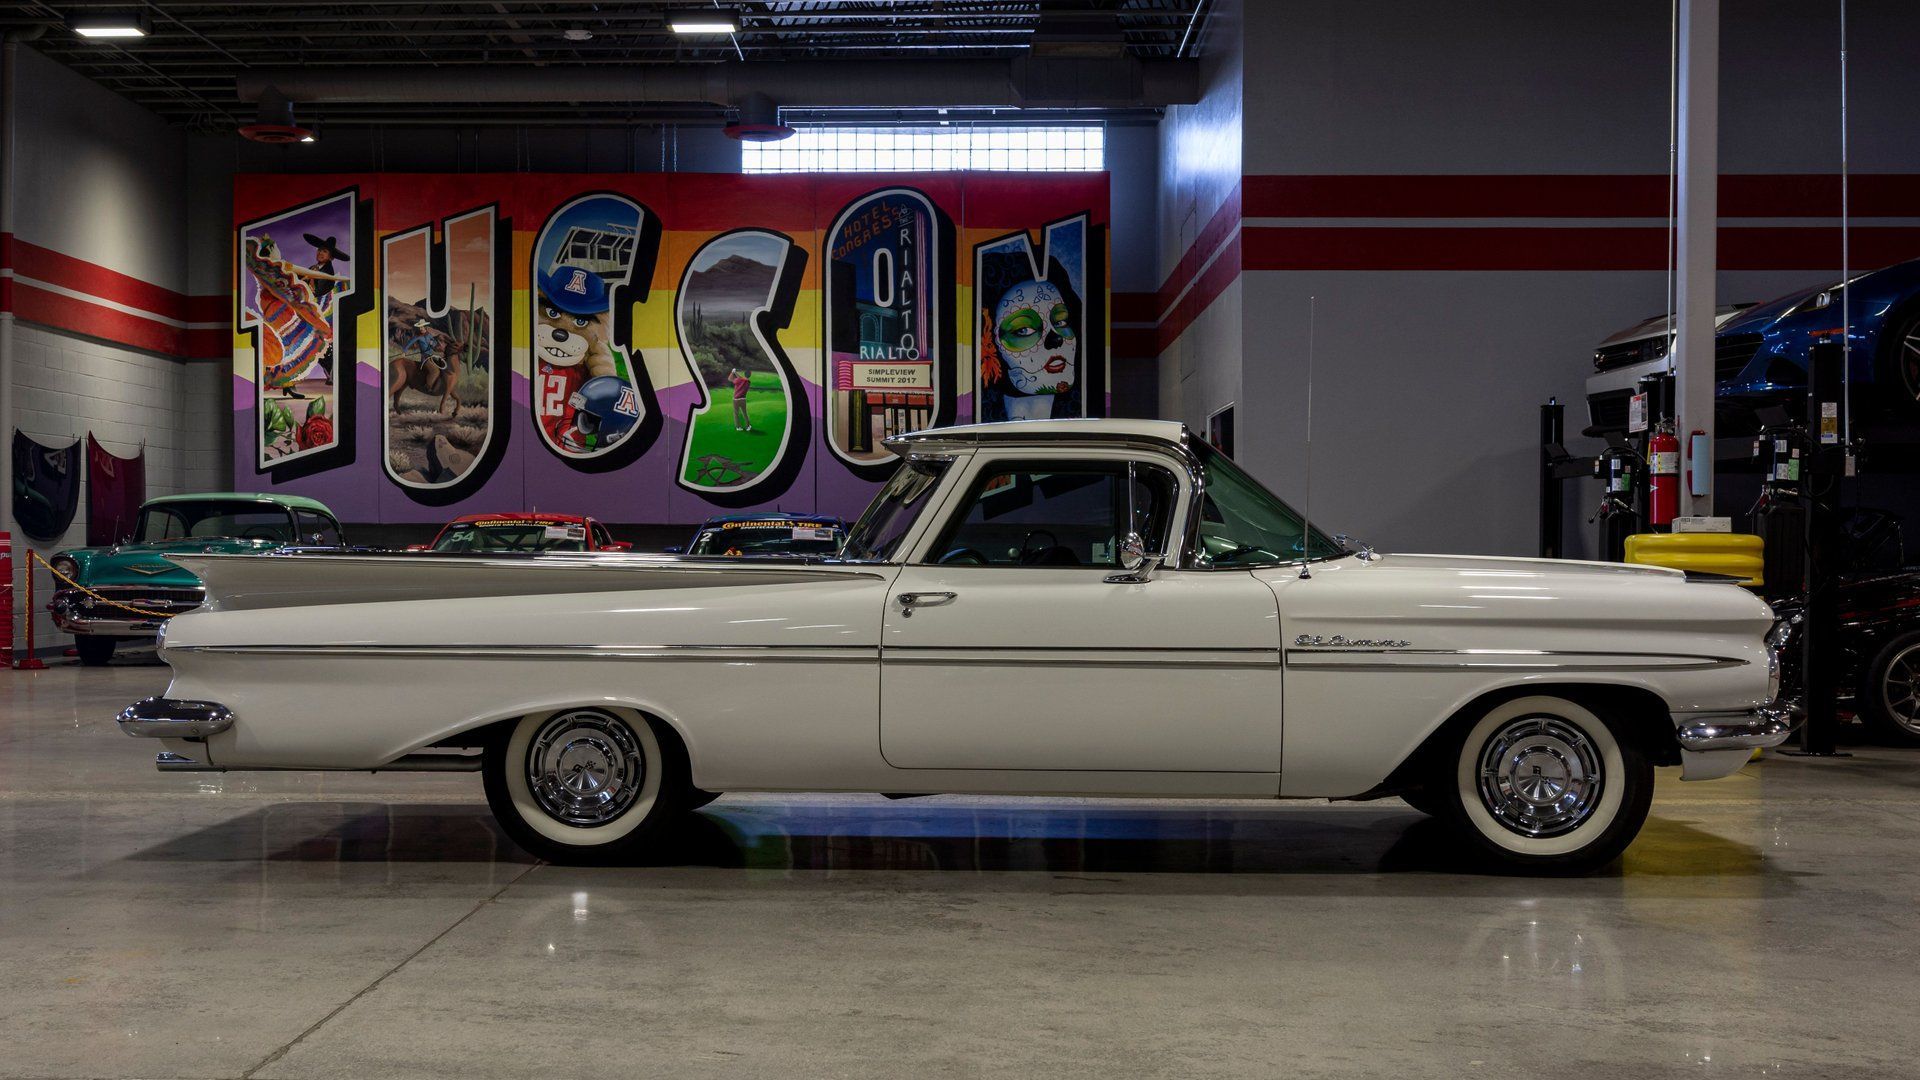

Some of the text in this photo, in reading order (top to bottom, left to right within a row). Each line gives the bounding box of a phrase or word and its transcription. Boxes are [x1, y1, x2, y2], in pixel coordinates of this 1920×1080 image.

[844, 201, 891, 238] HOTEL
[565, 270, 587, 295] A
[900, 228, 915, 351] RIALTO
[860, 346, 919, 360] RIALTO
[868, 368, 916, 376] SIMPLEVIEW
[866, 376, 895, 384] SUMMIT
[613, 386, 640, 418] A
[722, 521, 785, 530] Continental
[450, 531, 475, 542] 54
